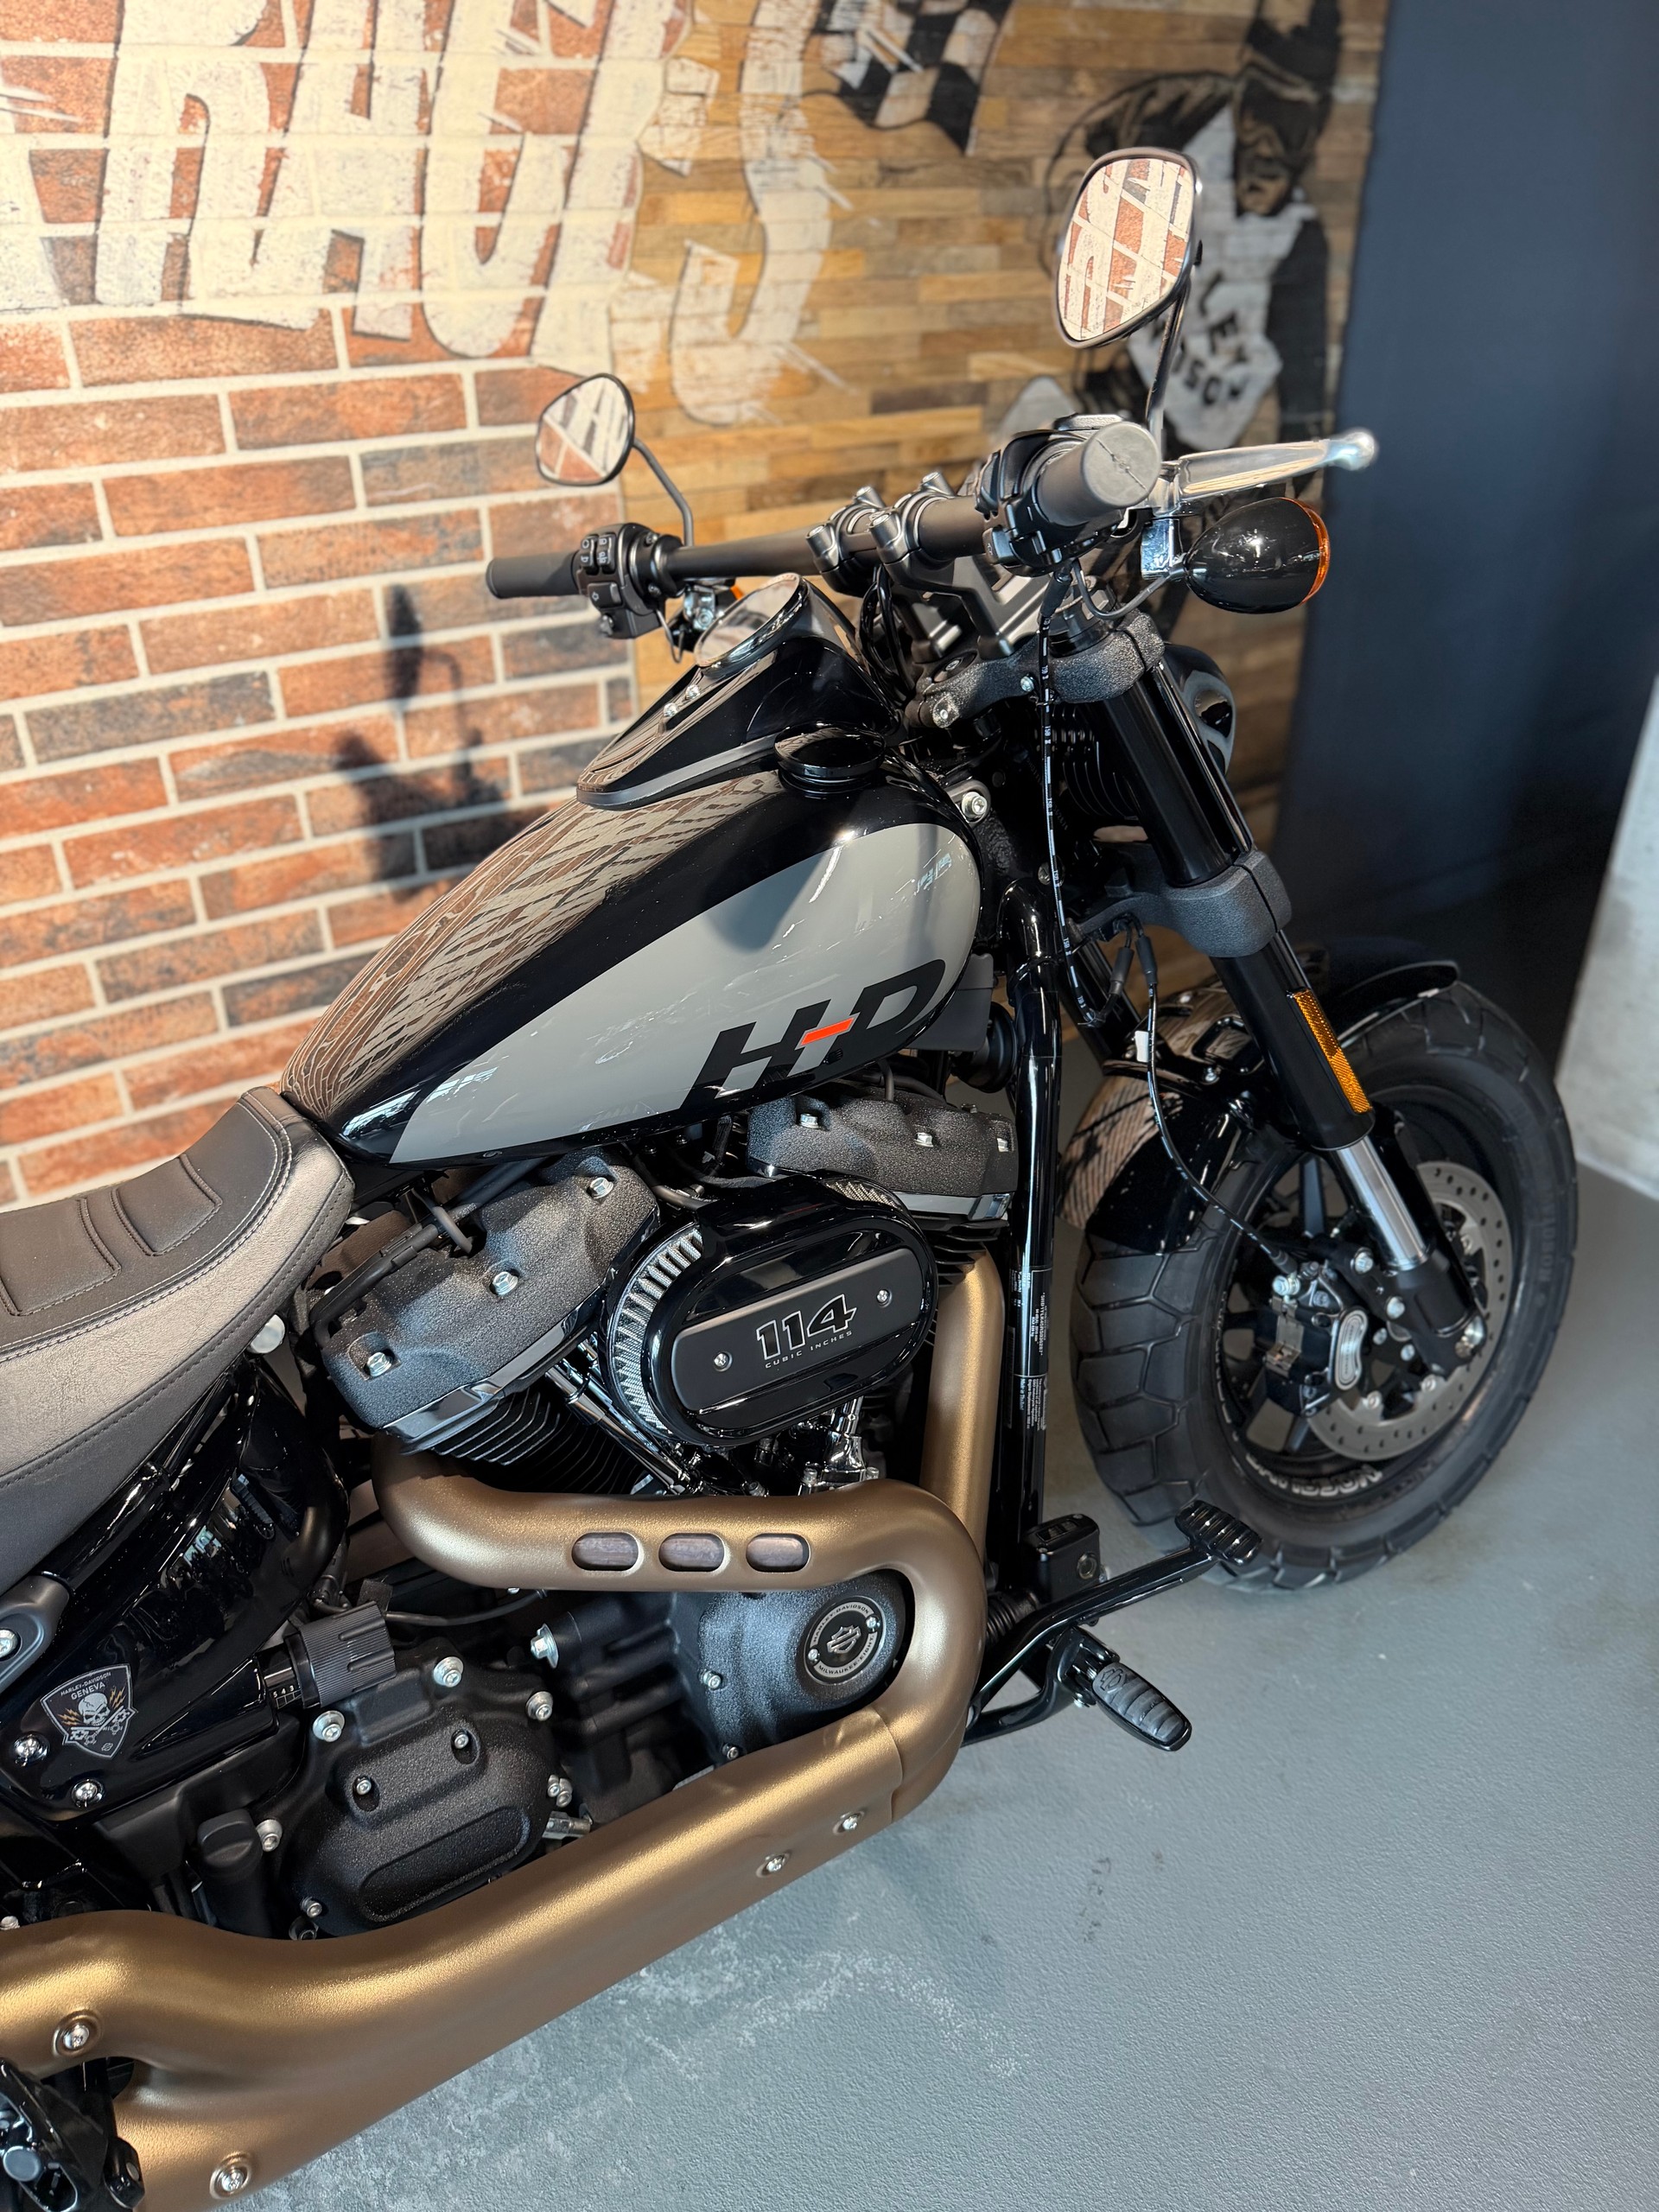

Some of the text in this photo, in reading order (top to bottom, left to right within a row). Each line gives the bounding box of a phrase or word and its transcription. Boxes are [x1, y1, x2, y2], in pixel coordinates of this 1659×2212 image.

[679, 958, 946, 1109] H-D
[756, 1294, 857, 1360] 114
[765, 1330, 853, 1369] CUBIC INCHES
[812, 1604, 870, 1643] HARLEY-DAVIDSON
[60, 1672, 111, 1697] HARLEY-DAVIDSON
[71, 1681, 105, 1700] GENEVA
